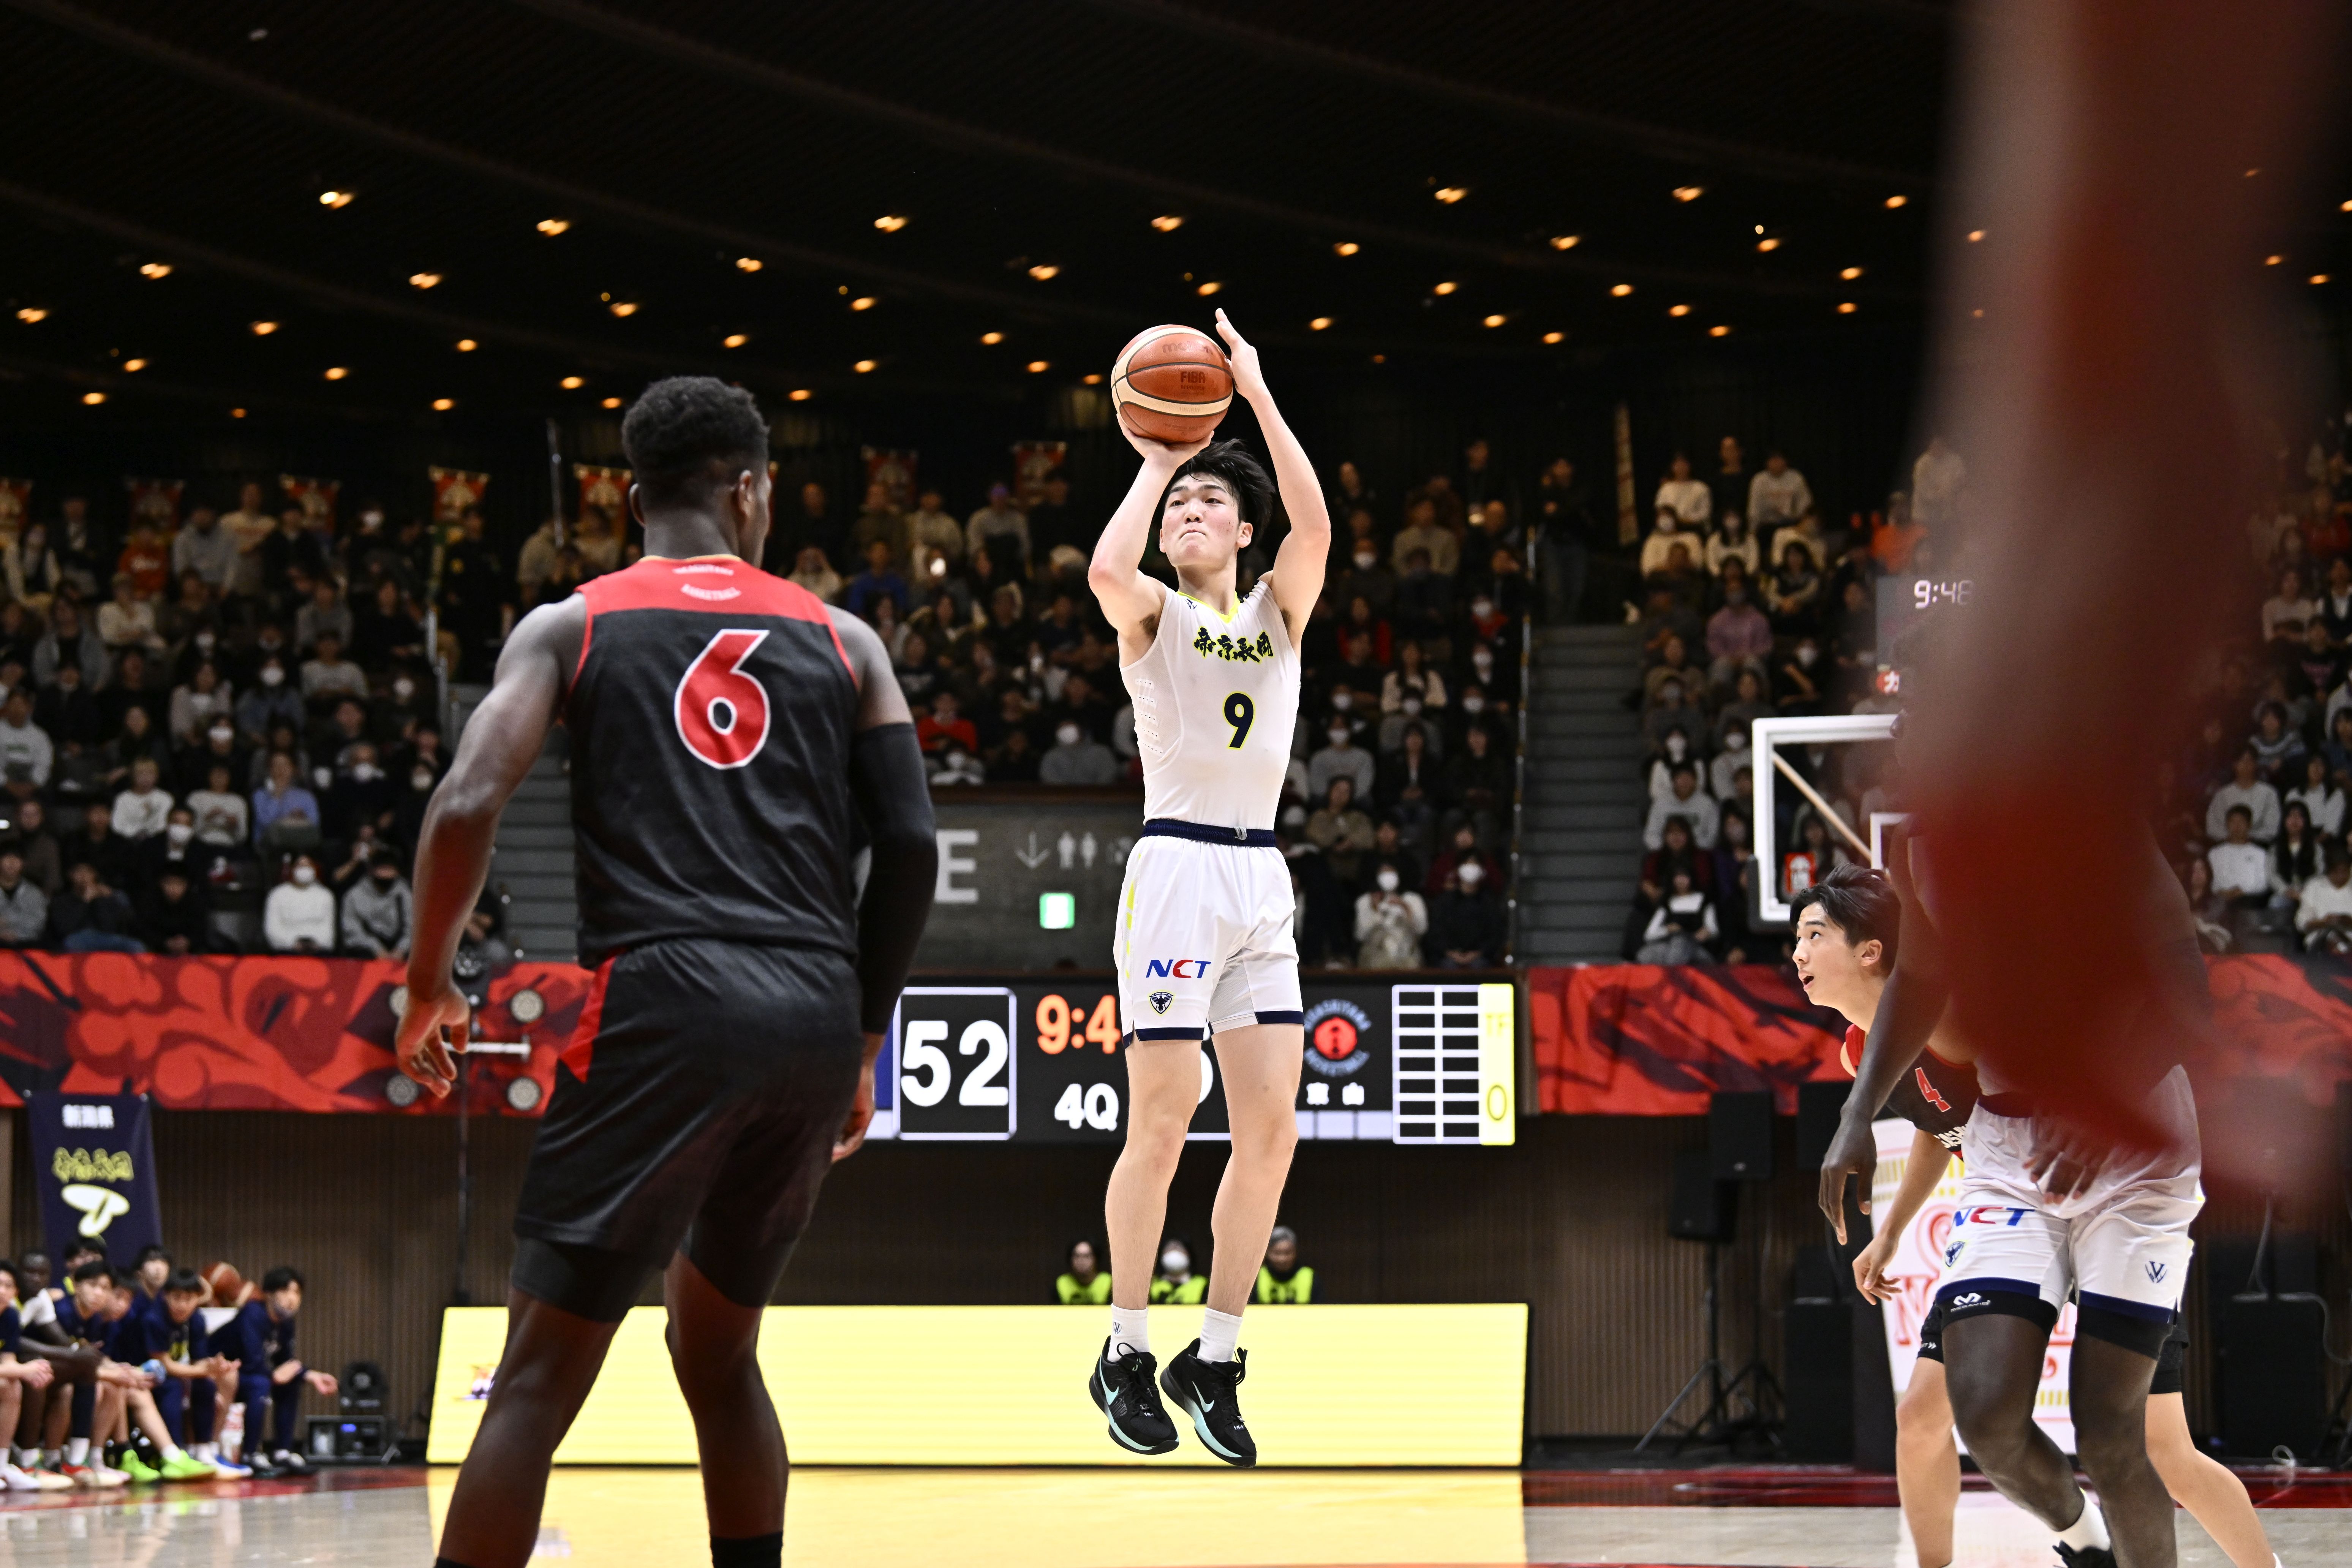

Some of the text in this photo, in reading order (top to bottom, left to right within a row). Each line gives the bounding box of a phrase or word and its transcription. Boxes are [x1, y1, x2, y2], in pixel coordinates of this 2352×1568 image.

[1181, 371, 1206, 383] FIBA
[1192, 626, 1275, 664] 帝京長岡
[674, 628, 771, 770] 6
[1222, 691, 1256, 750] 9
[934, 829, 980, 903] E
[1146, 959, 1212, 979] NCT
[1035, 994, 1122, 1055] 9:4
[900, 1020, 1009, 1107] 52
[1914, 1067, 1952, 1113] 4
[1054, 1083, 1119, 1132] 4Q
